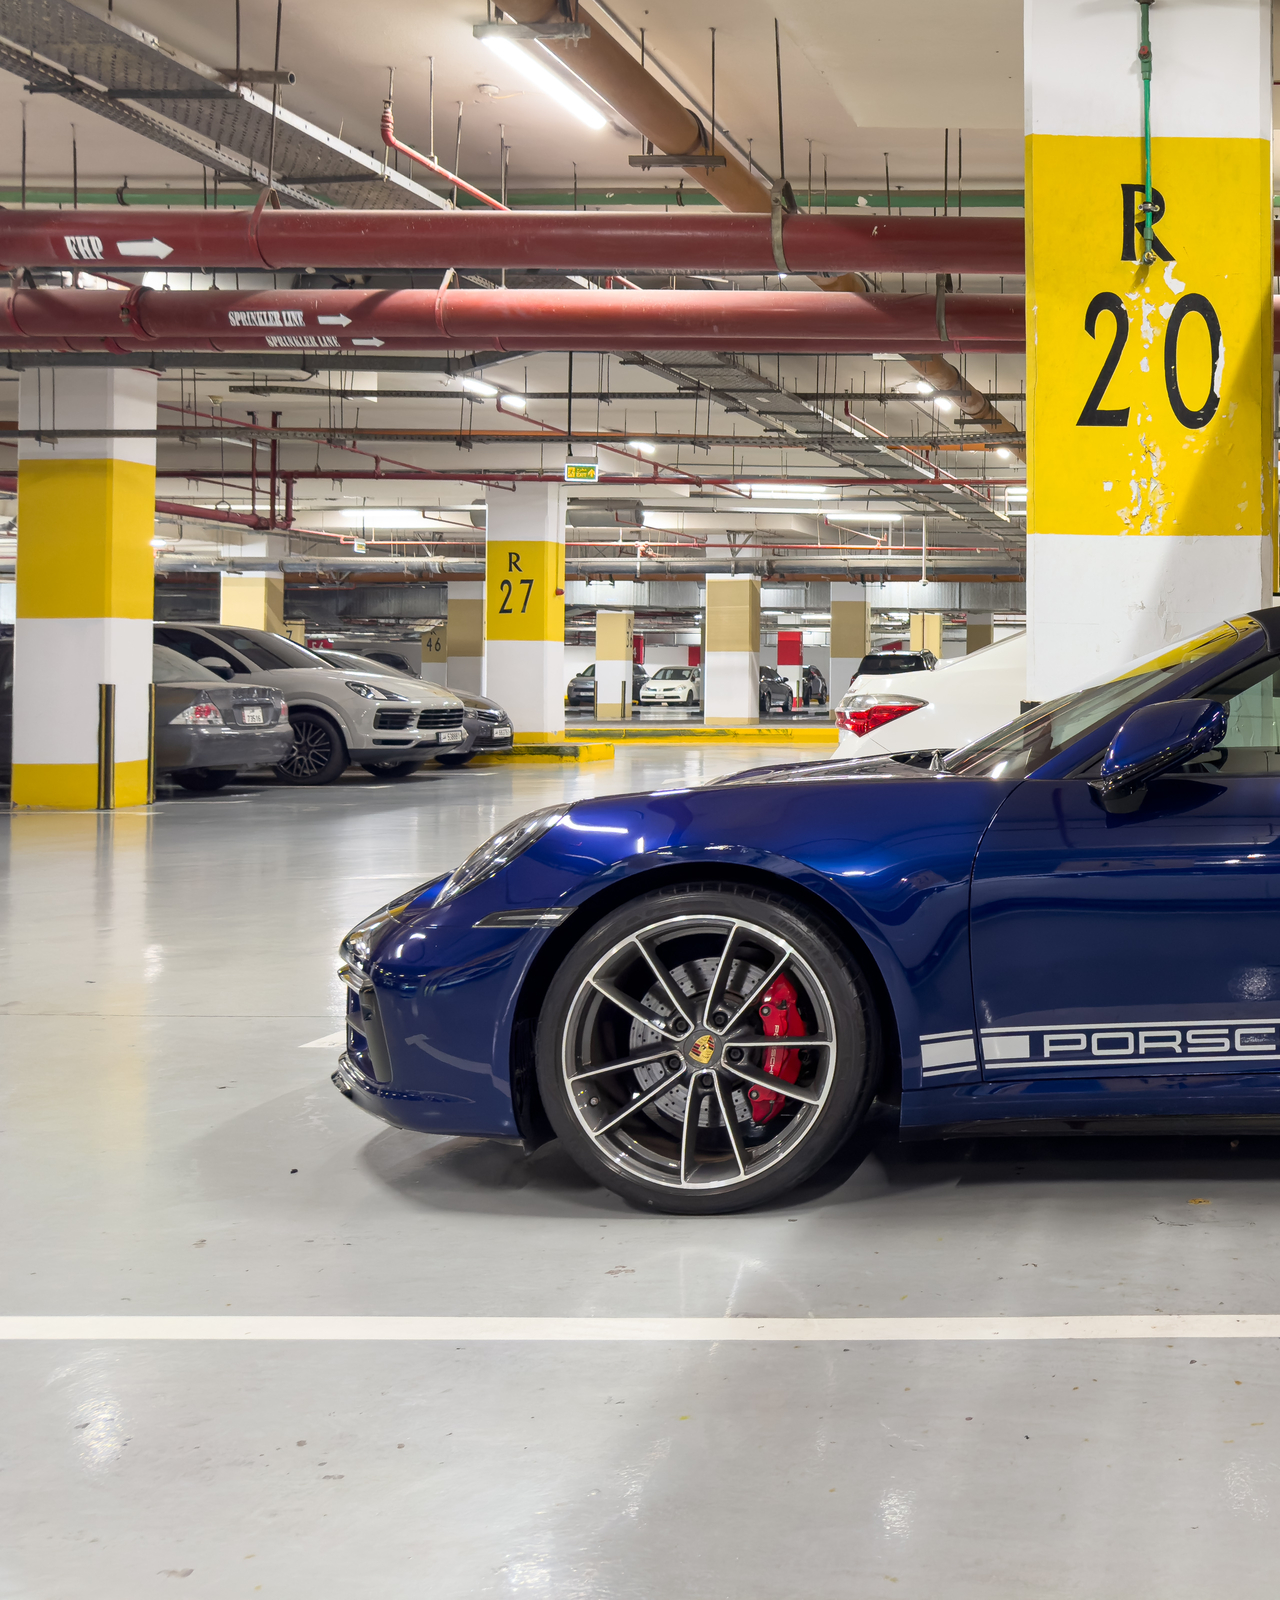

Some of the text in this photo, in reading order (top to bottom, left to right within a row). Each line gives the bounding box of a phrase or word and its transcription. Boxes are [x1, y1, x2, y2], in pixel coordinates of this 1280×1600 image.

[1121, 183, 1176, 261] R
[64, 235, 104, 260] FHP
[228, 310, 305, 327] SPRINKLER LINE
[265, 335, 341, 348] SPRINKLER LINE
[1076, 291, 1223, 429] 20
[508, 552, 522, 572] R
[499, 579, 534, 614] 27
[426, 638, 441, 652] 46
